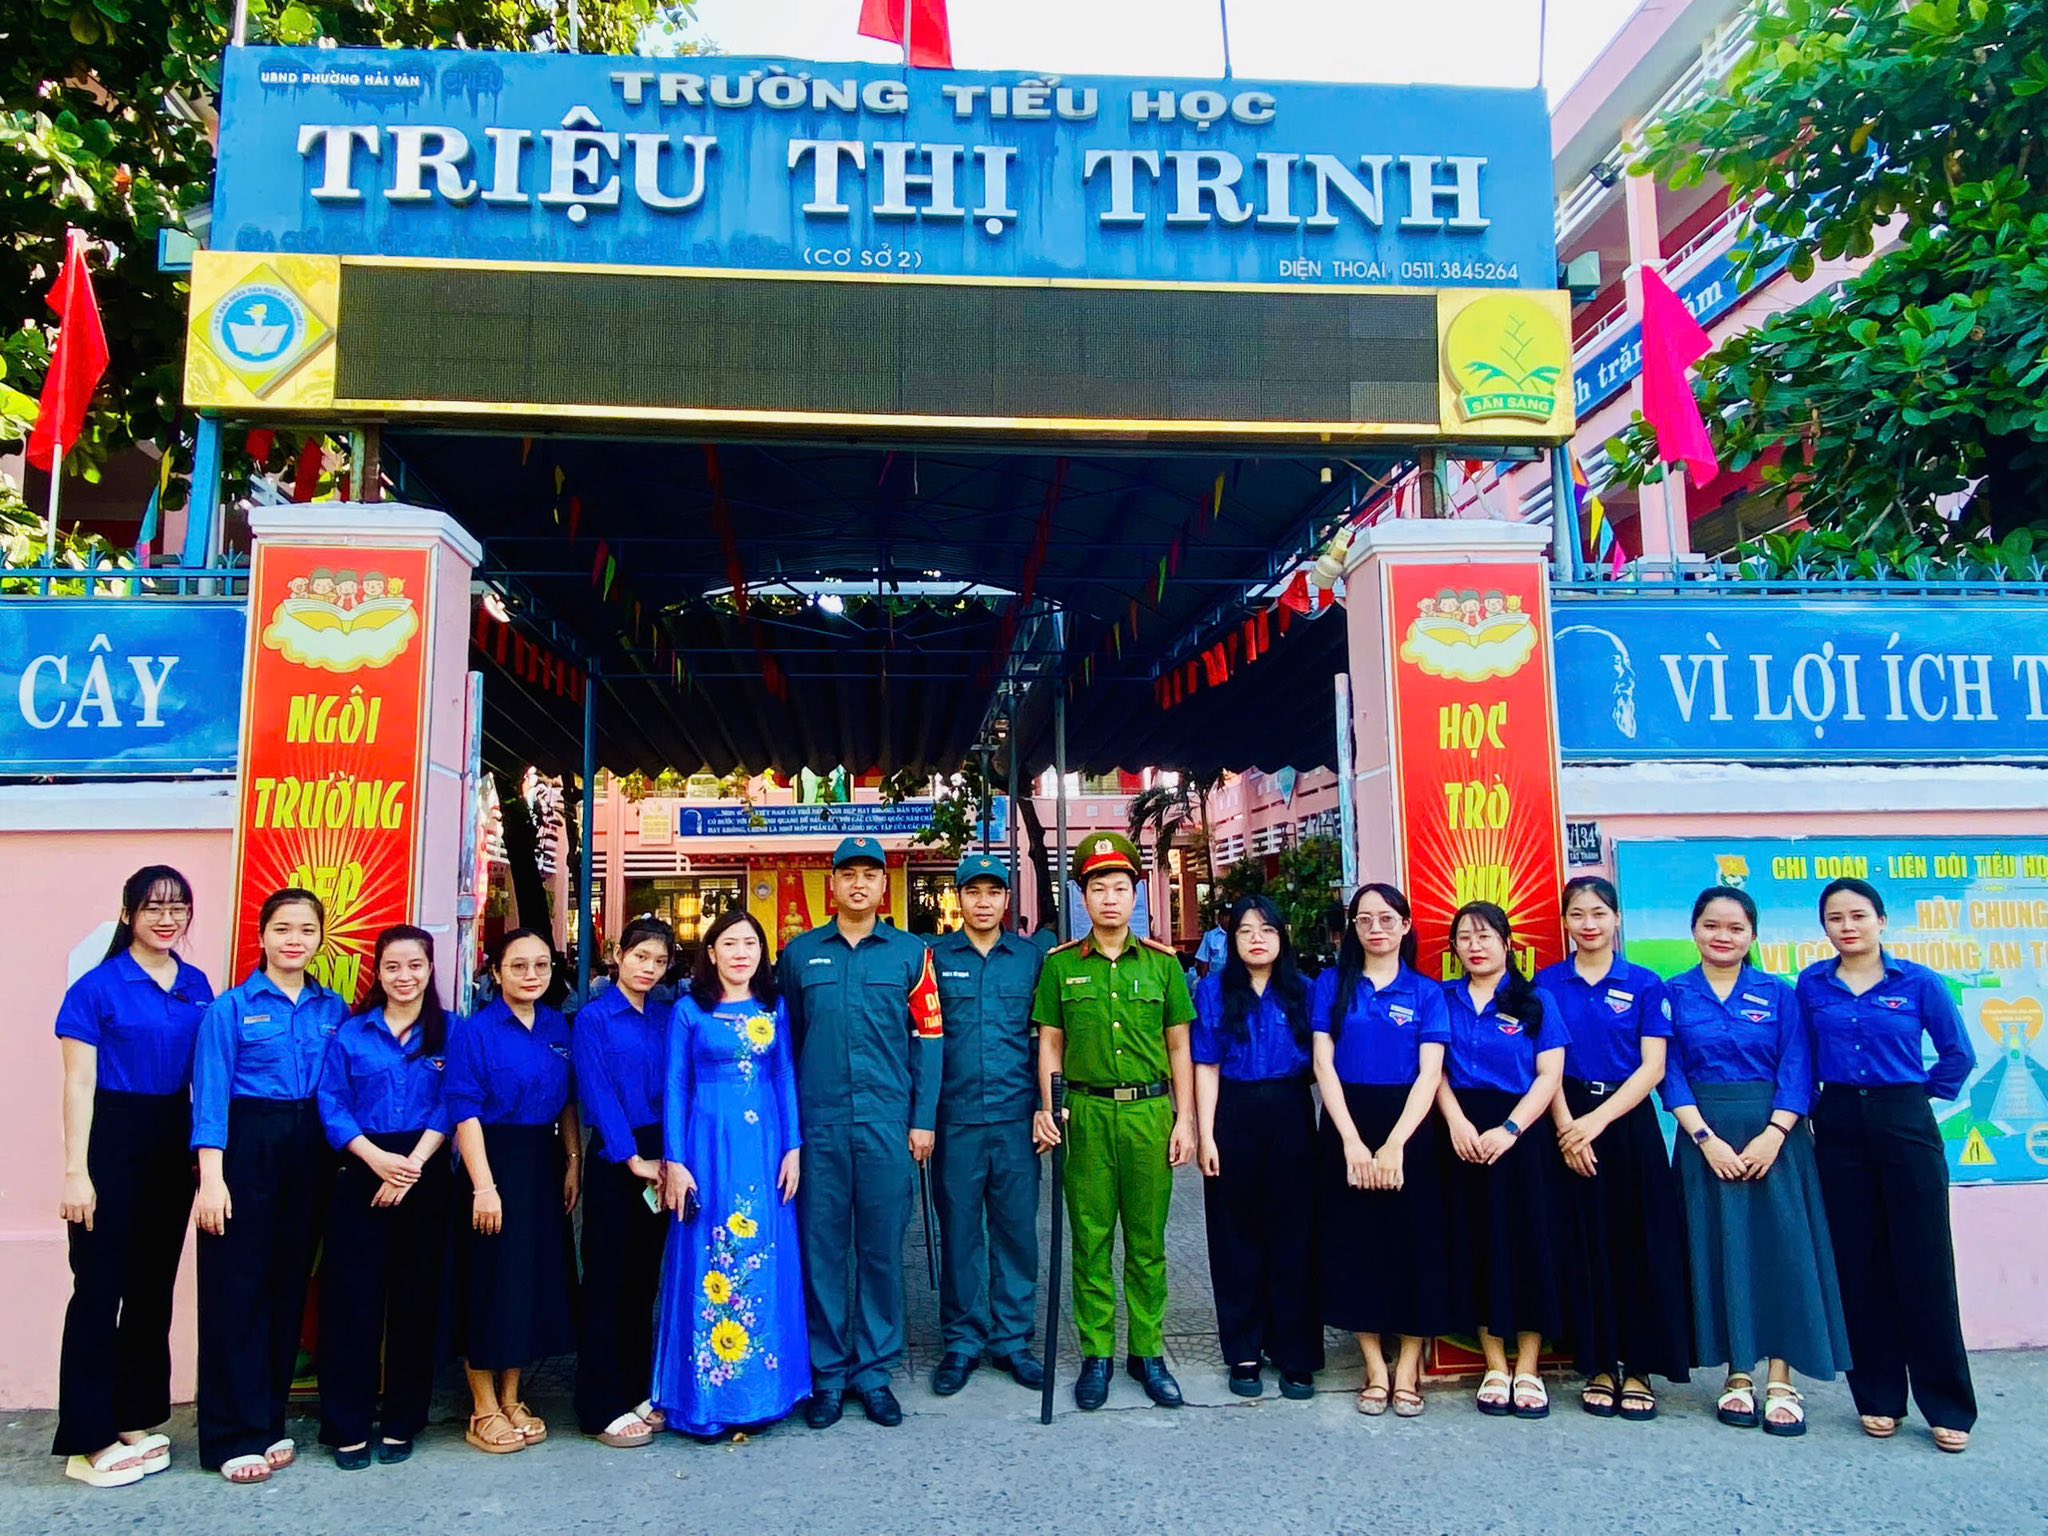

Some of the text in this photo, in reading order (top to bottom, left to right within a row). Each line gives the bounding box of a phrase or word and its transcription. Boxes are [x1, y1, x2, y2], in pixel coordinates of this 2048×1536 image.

[261, 69, 420, 87] UBND PHƯỜNG HẢI VÂN
[610, 66, 1277, 131] TRƯỜNG TIỂU HỌC
[297, 106, 1491, 236] TRIỆU THỊ TRINH
[803, 242, 922, 269] (CƠ SỞ 2)
[1279, 257, 1322, 280] ĐIỆN
[1401, 260, 1519, 281] 0511.3845264
[18, 633, 180, 730] CÂY
[1660, 631, 1733, 722] VÌ
[1749, 640, 1866, 739] LỢI
[1881, 631, 1998, 722] ÍCH
[286, 684, 382, 744] NGÔI
[1439, 701, 1508, 758] HỌC
[254, 771, 407, 830] TRƯỜNG
[1444, 773, 1510, 830] TRÒ
[1772, 856, 1808, 880] CHI
[1887, 851, 1928, 879] LIÊN
[1934, 851, 1968, 882] ĐỘI
[1973, 848, 2017, 879] TIỂU
[1915, 895, 2048, 930] HÃY CHUNG
[1988, 940, 2023, 970] AN
[2030, 940, 2048, 970] T
